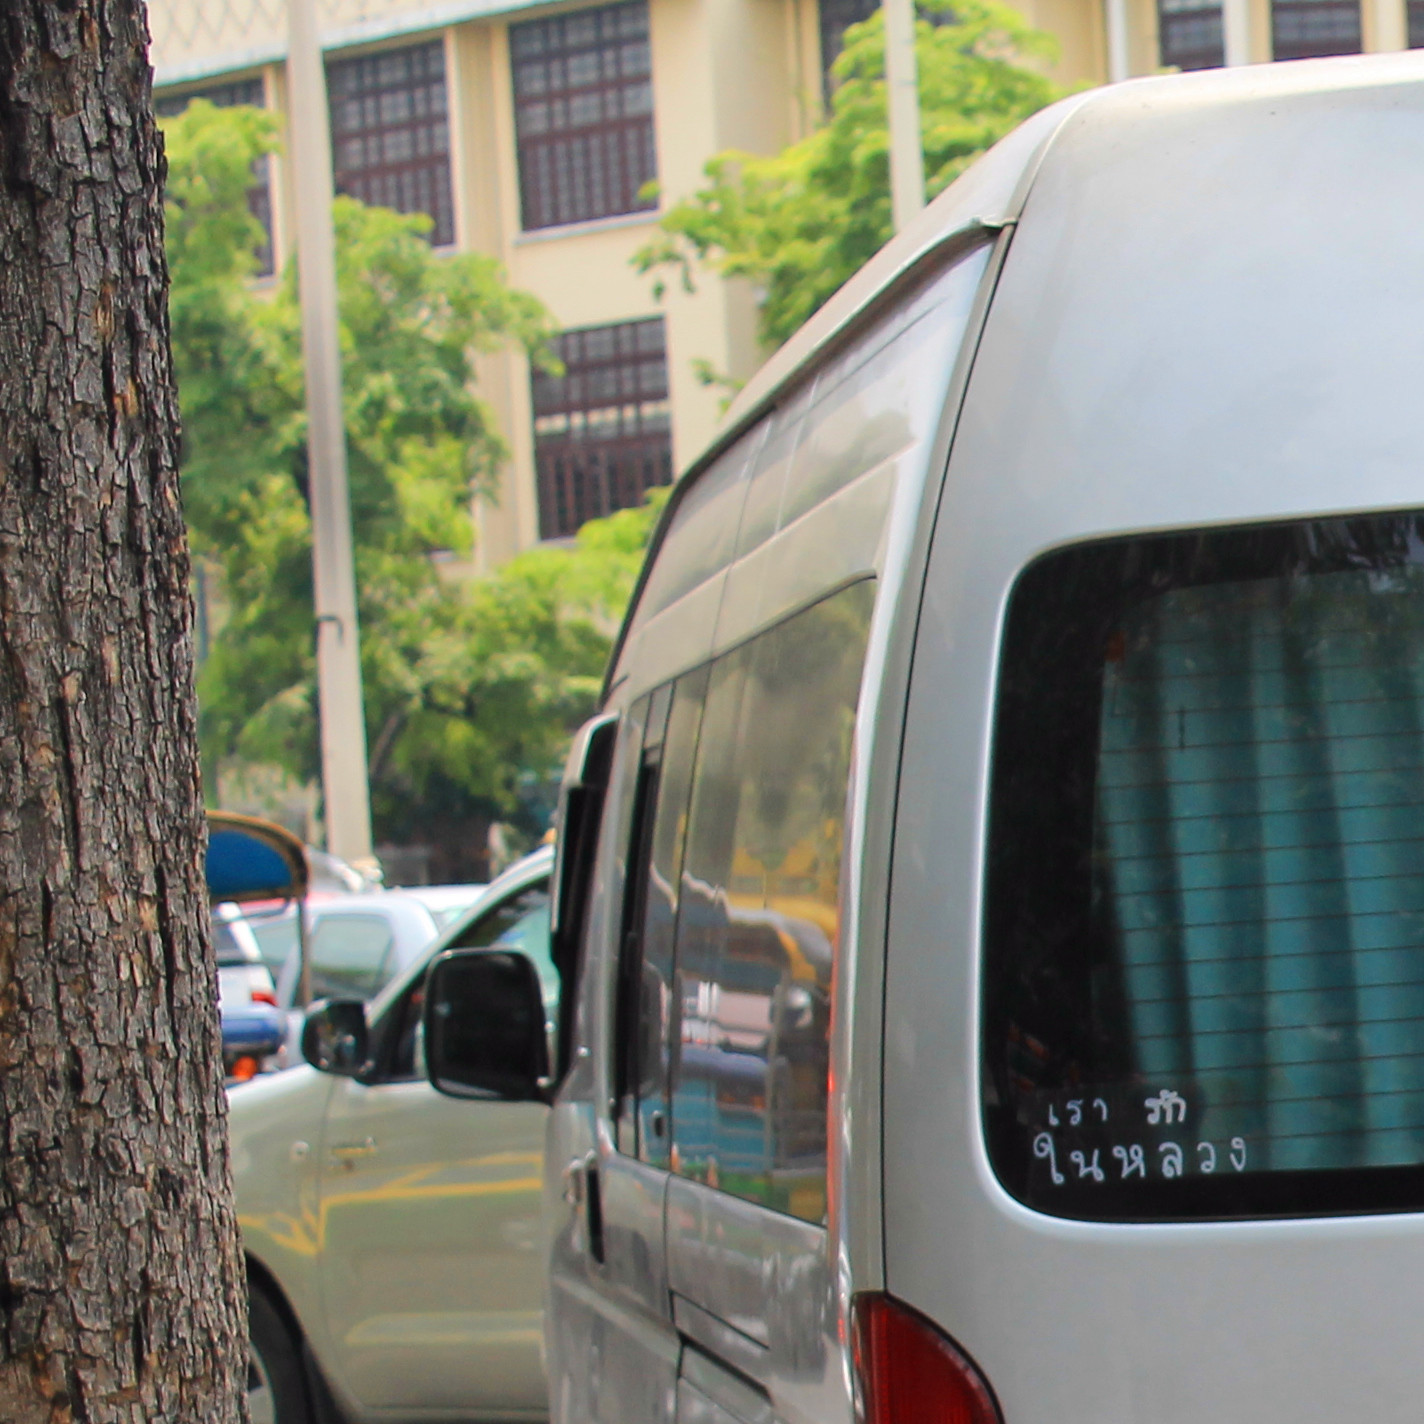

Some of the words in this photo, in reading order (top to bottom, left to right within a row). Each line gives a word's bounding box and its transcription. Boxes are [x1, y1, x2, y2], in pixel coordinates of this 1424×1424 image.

[1048, 1097, 1109, 1126] เรา
[1143, 1088, 1188, 1125] รัก
[1032, 1131, 1248, 1185] ในหลวง
